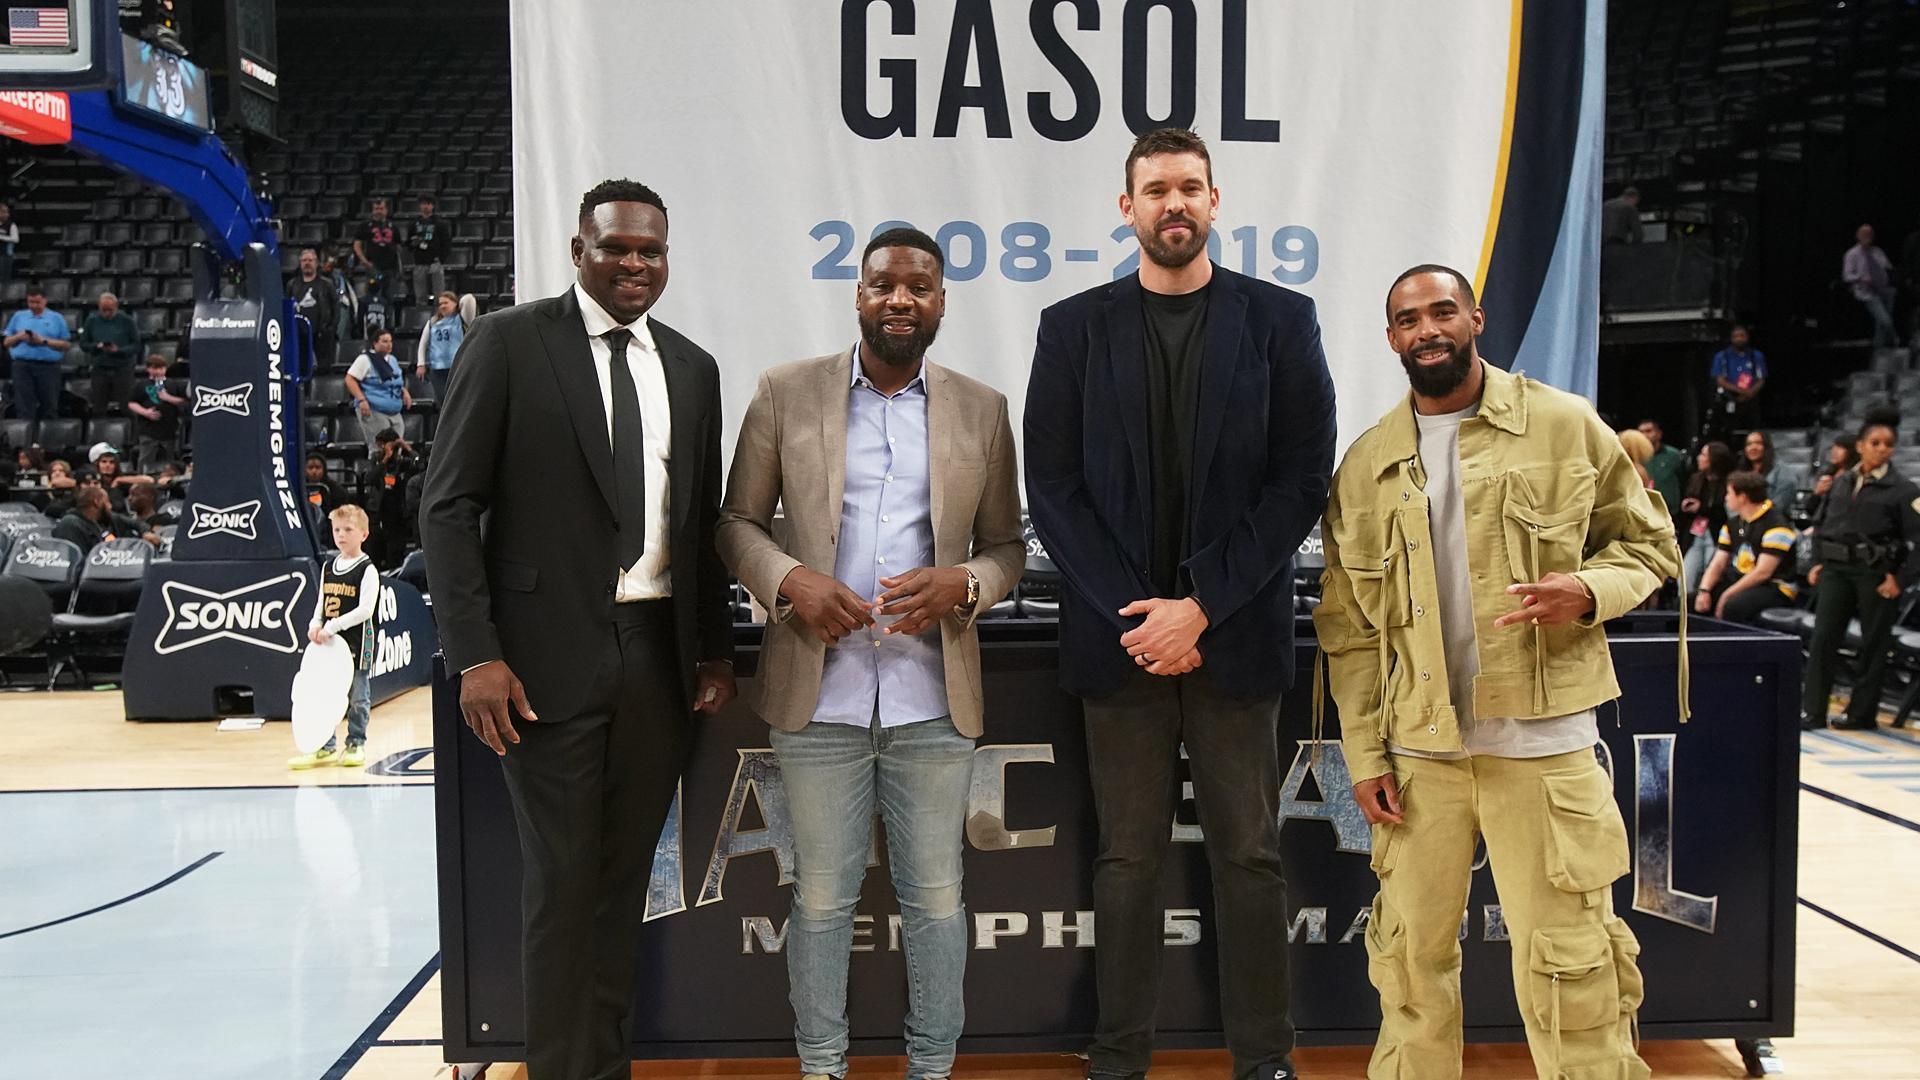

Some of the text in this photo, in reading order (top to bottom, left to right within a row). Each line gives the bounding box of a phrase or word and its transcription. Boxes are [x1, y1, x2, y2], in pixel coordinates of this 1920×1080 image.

[840, 0, 1280, 142] GASOL
[372, 227, 393, 243] 33
[435, 328, 450, 342] 33
[200, 393, 244, 407] SONIC
[266, 319, 302, 530] @MEMGRIZZ
[197, 512, 251, 528] SONIC
[175, 600, 285, 630] SONIC
